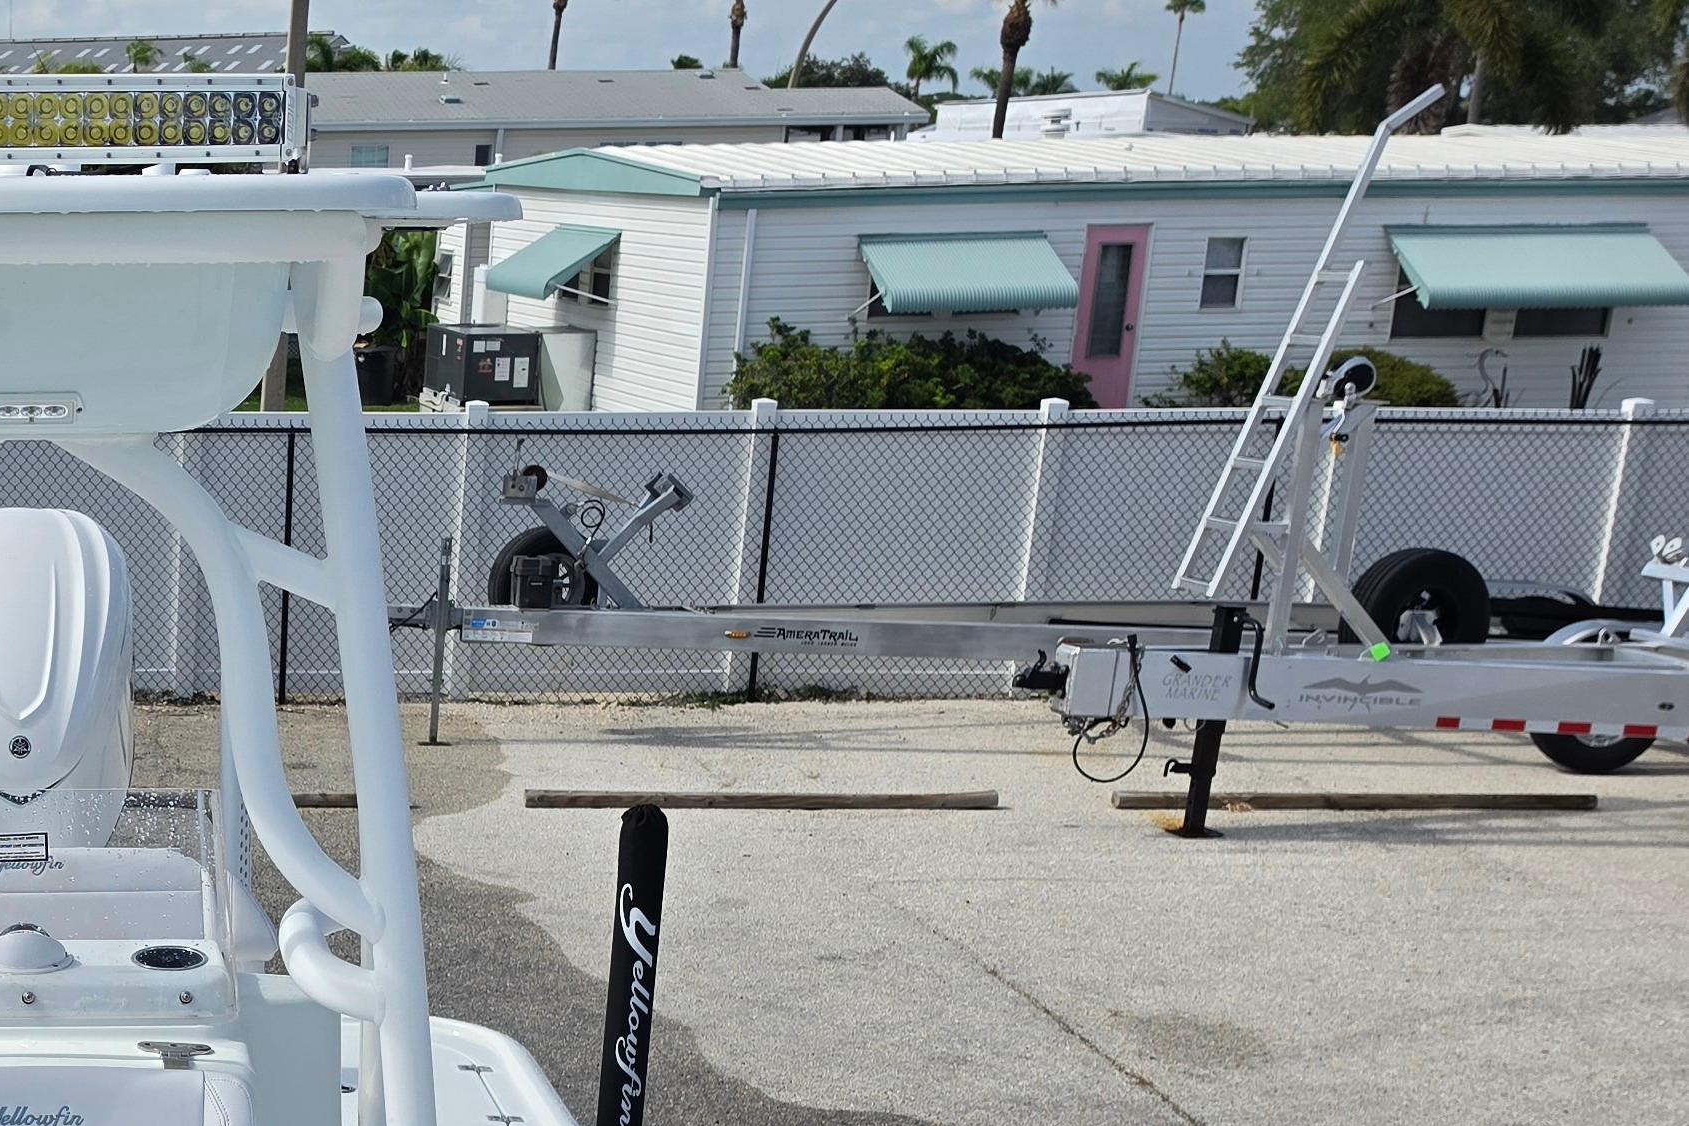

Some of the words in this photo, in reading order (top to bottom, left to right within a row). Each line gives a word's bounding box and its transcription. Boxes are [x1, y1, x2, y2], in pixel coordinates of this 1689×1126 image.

[1162, 672, 1233, 689] GRANDER
[1165, 687, 1222, 702] MARINE
[1298, 694, 1421, 706] INVINCIBLE
